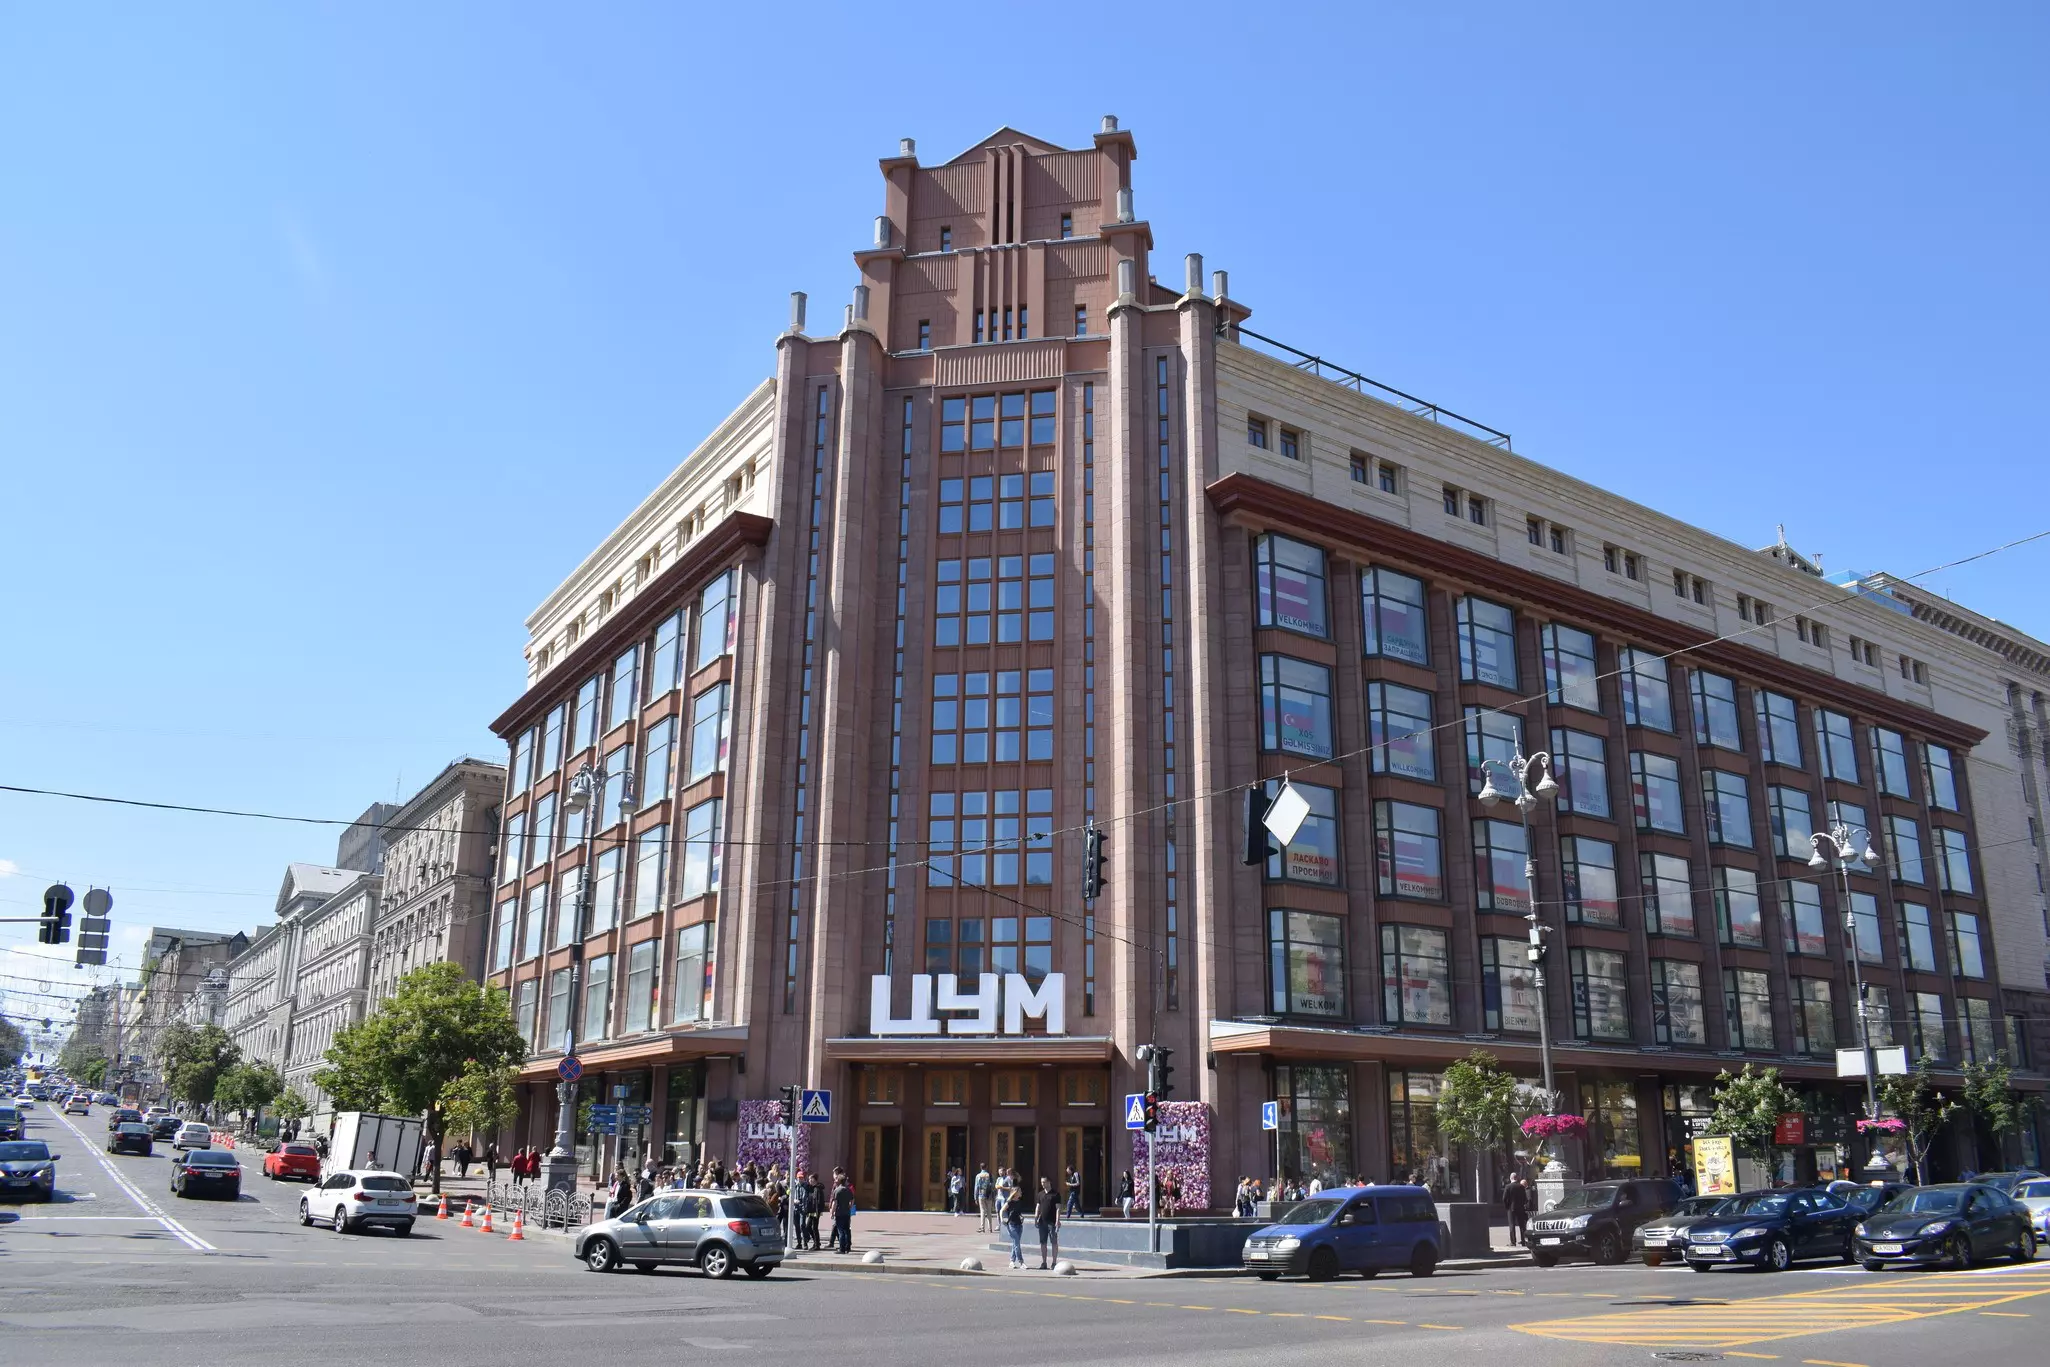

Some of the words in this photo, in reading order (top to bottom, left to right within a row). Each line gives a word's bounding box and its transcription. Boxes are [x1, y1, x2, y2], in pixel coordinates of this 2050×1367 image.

[1278, 613, 1325, 634] VELKOMMEN
[1391, 762, 1433, 777] WILLKOMMEN
[1293, 853, 1329, 866] ЛАСКАВО
[870, 972, 1066, 1035] ЦУМ
[1300, 998, 1336, 1011] WELKOM
[748, 1123, 793, 1139] ЦУМ
